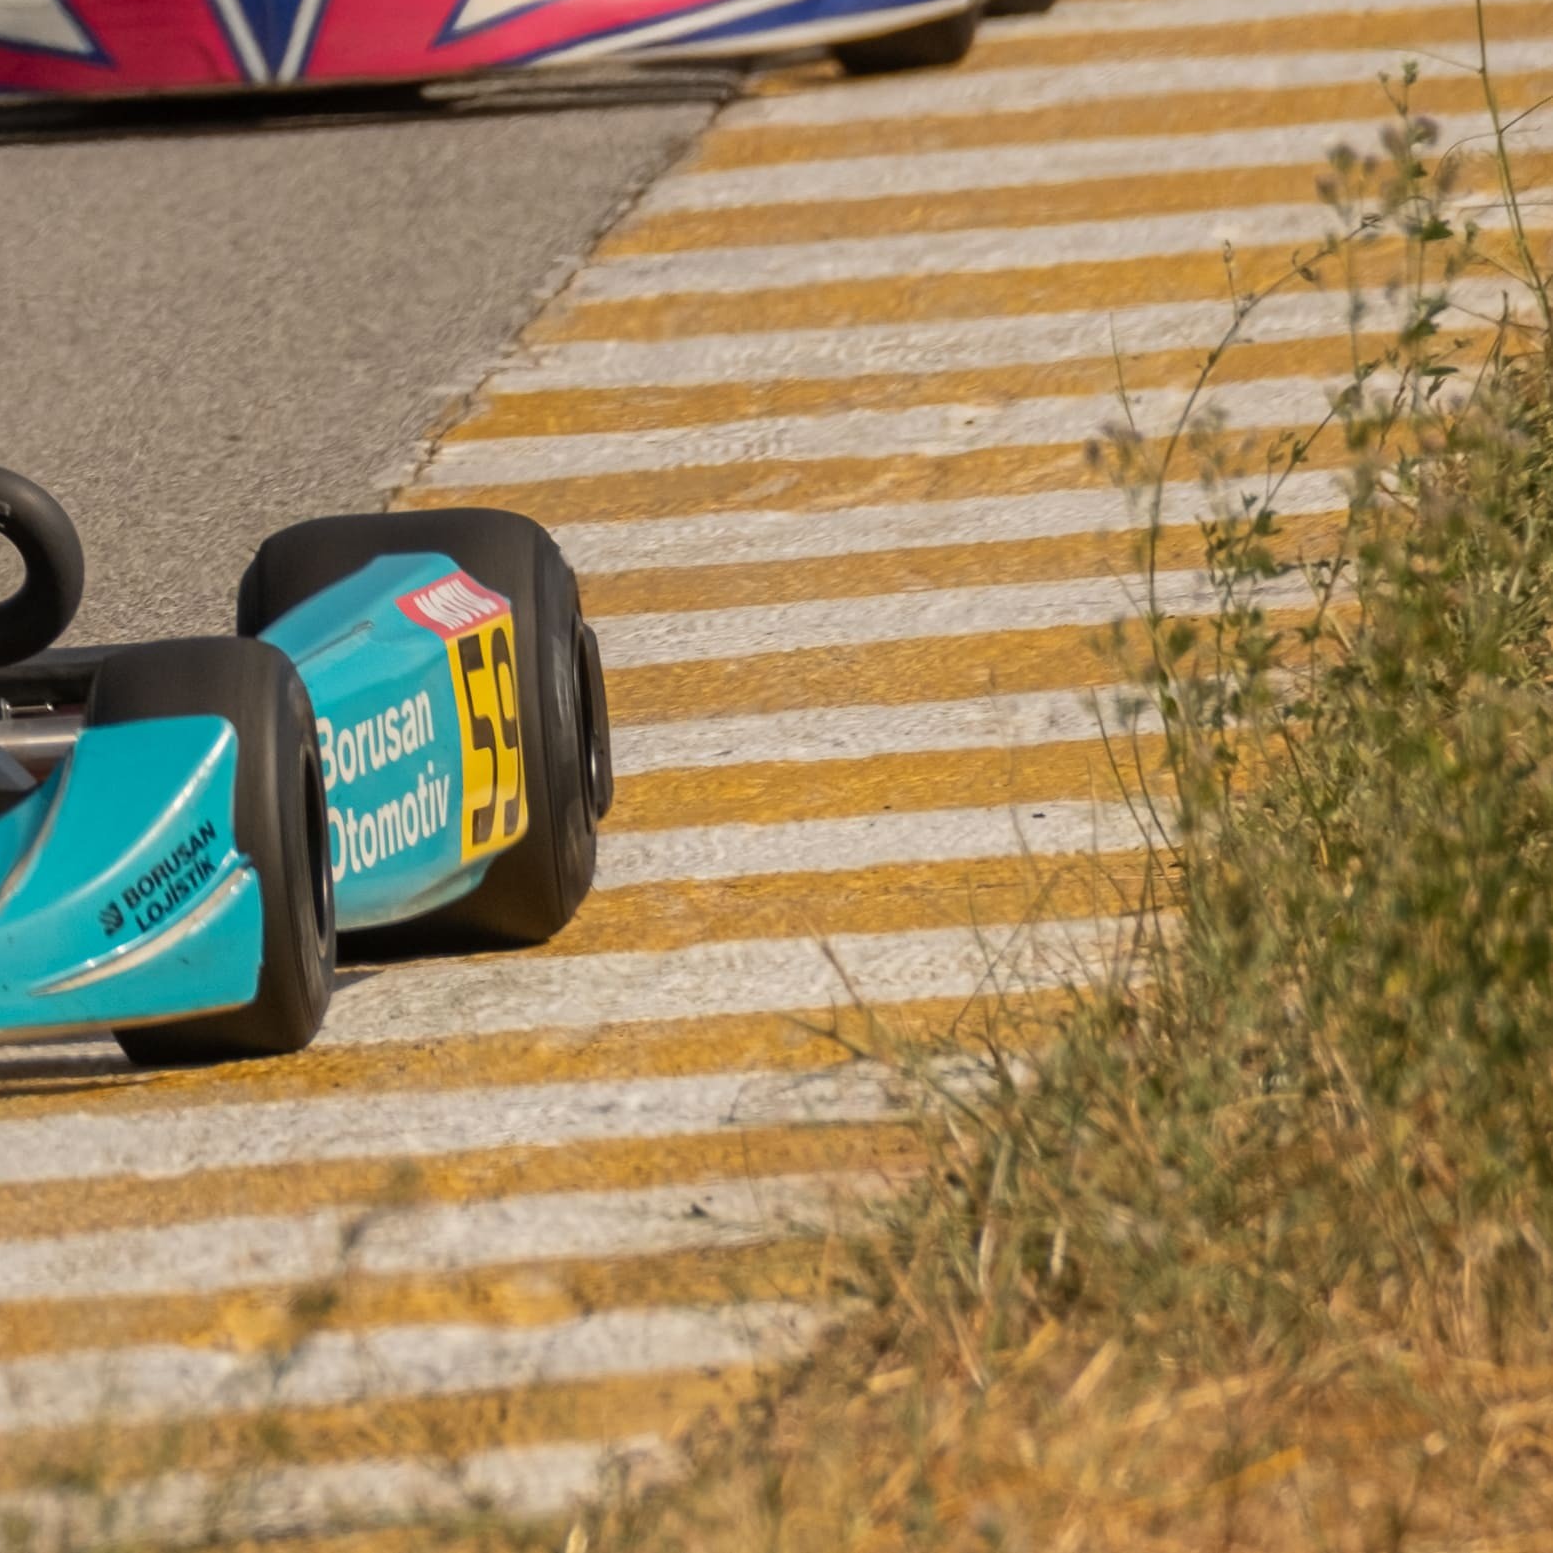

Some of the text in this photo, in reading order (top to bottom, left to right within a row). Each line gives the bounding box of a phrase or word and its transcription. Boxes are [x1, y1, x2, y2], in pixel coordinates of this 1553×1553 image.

[316, 690, 435, 792] Borusan
[457, 626, 523, 848] 59
[122, 819, 217, 910] BORUSAN
[327, 760, 451, 884] Otomotiv
